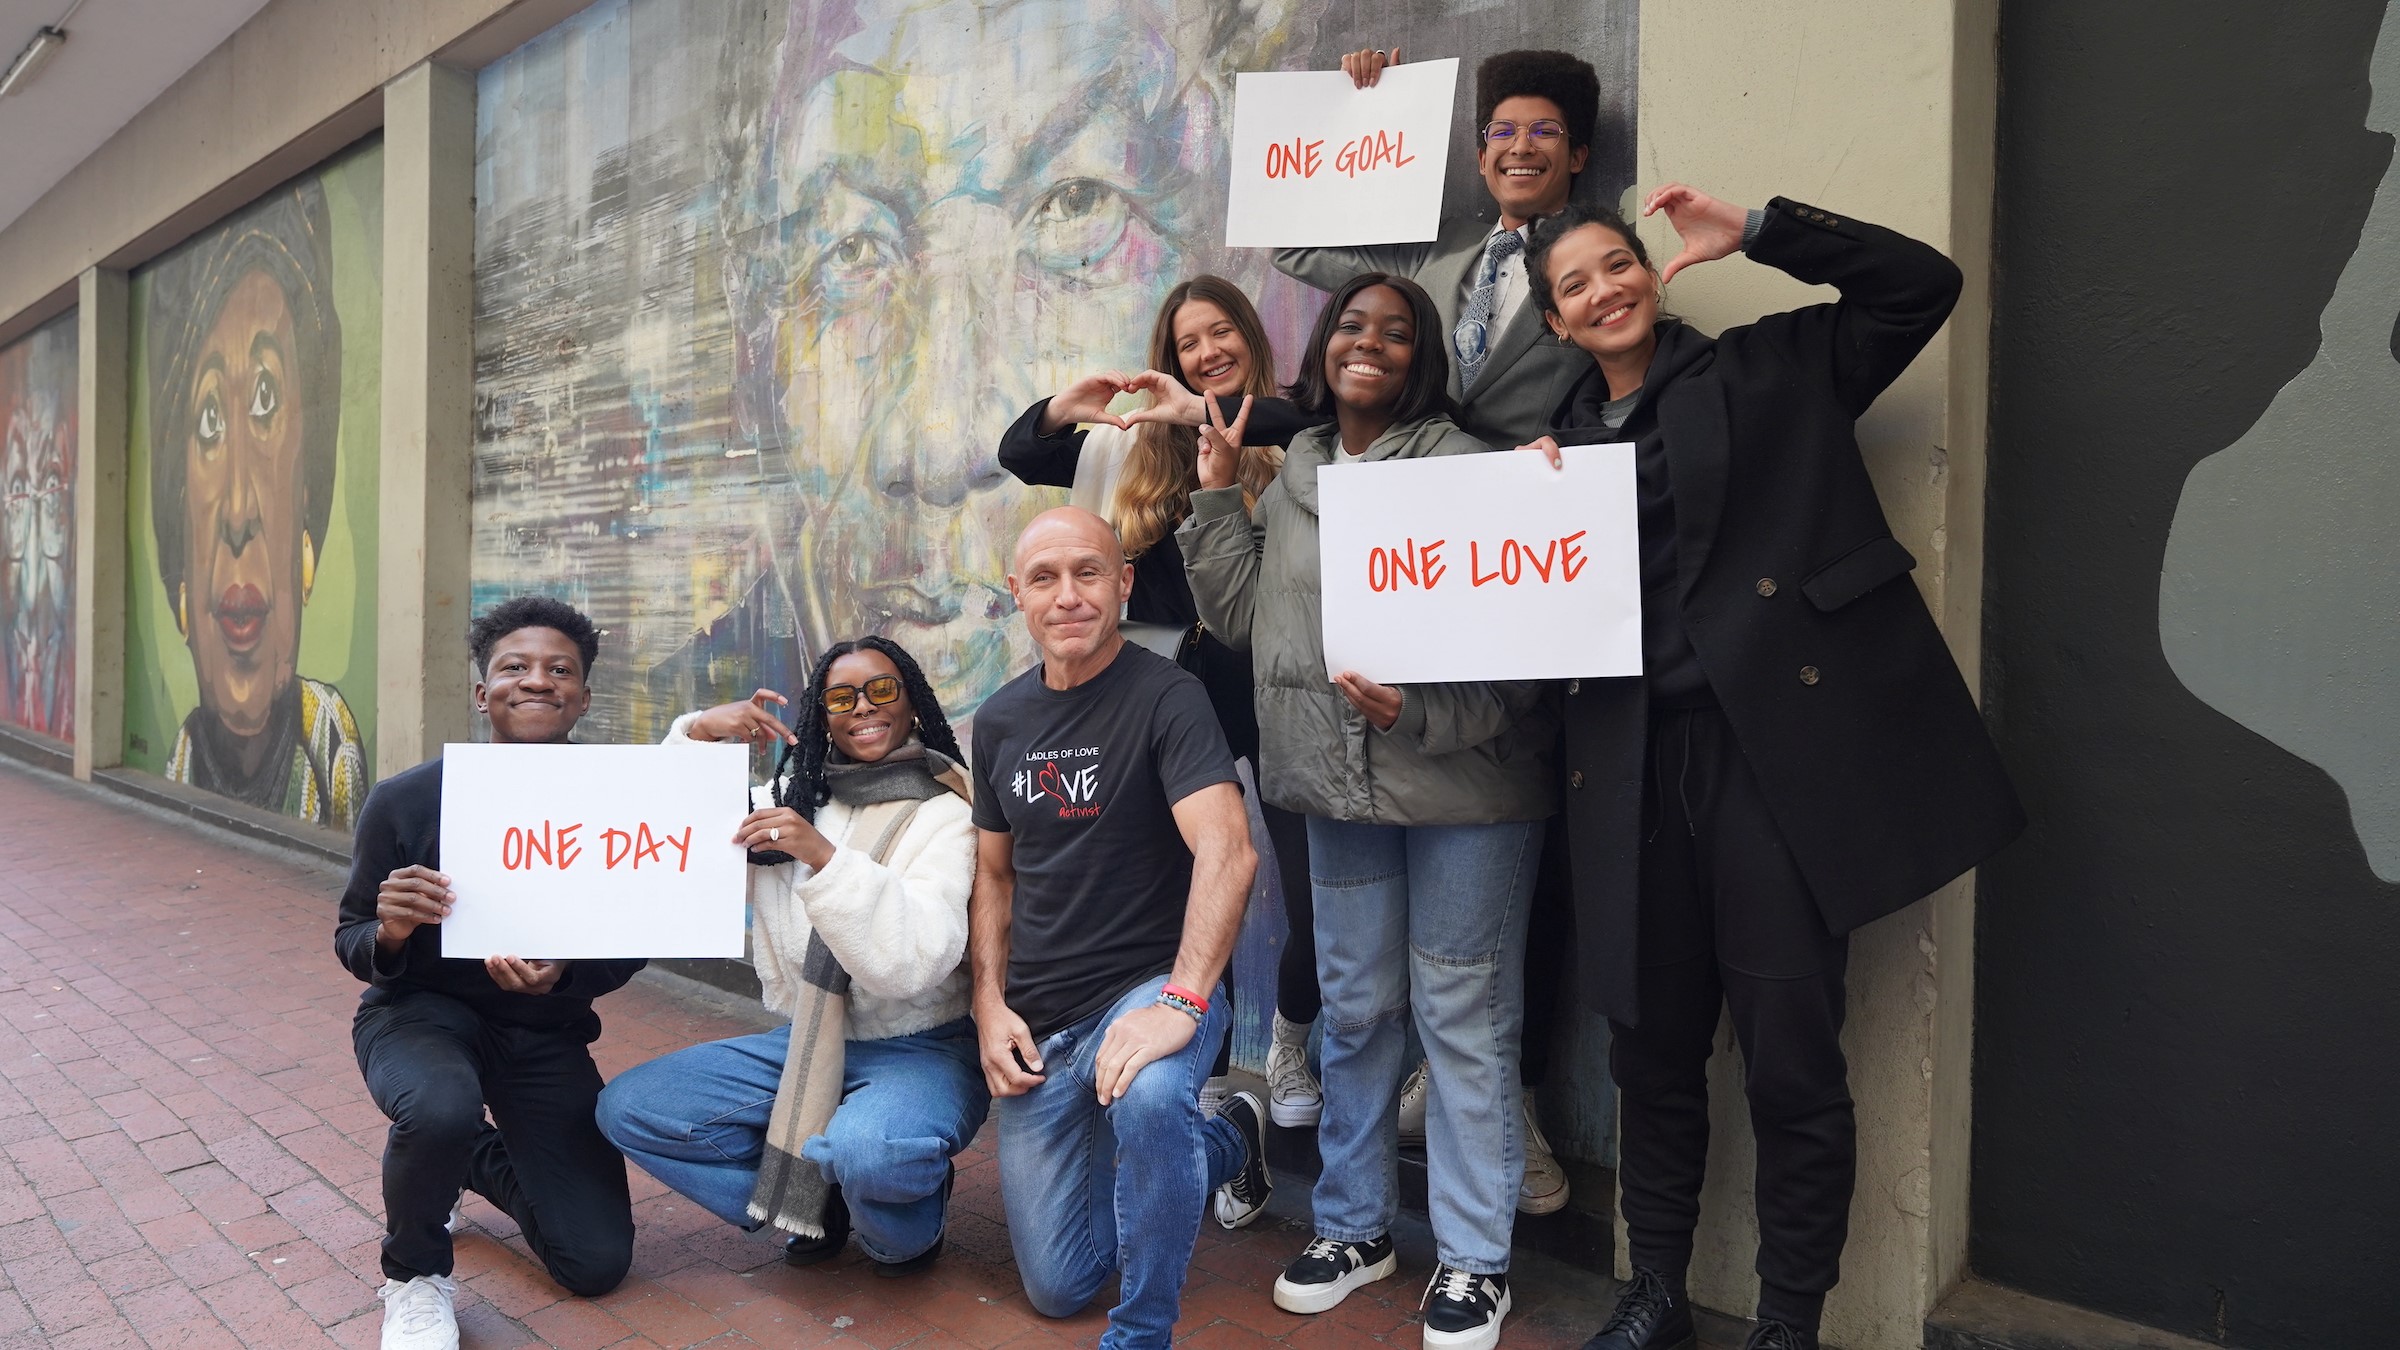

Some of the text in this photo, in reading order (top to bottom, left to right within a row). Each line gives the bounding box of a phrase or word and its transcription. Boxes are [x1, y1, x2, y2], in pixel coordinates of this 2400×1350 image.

[1266, 130, 1416, 180] ONE GOAL
[1368, 529, 1589, 593] ONE LOVE
[1026, 746, 1099, 761] LADLES OF LOVE
[502, 819, 693, 873] ONE DAY
